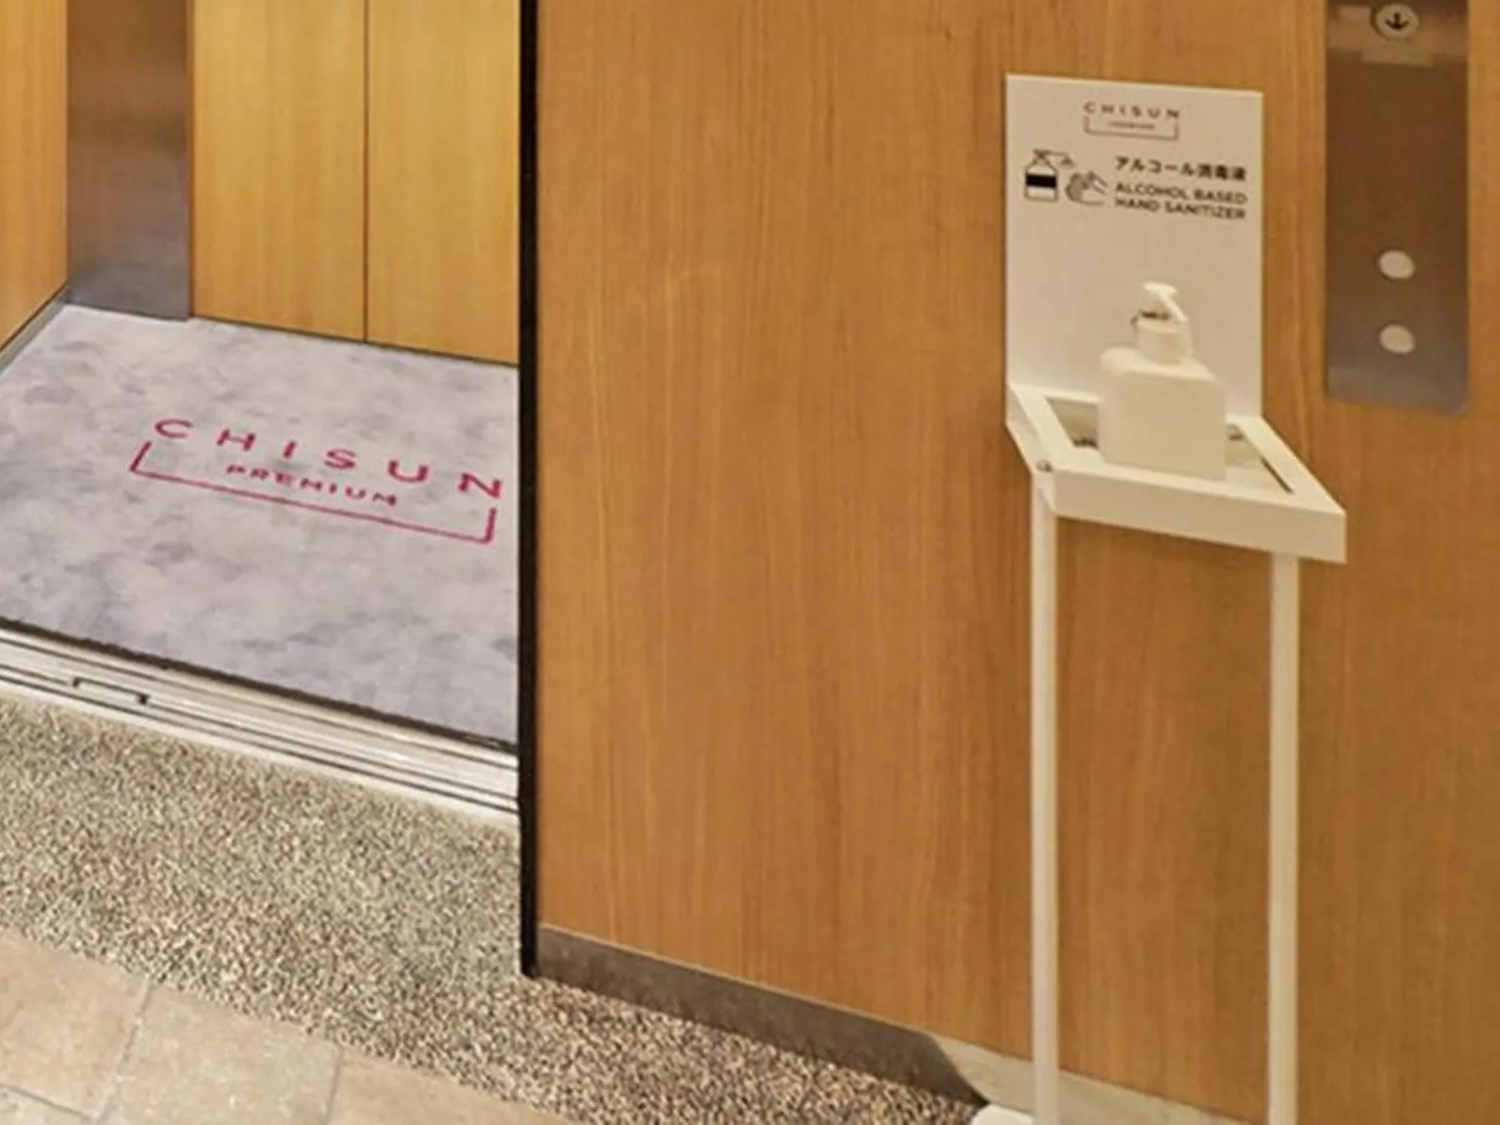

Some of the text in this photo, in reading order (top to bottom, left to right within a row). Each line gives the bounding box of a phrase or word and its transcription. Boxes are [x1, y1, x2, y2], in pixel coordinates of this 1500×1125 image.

[1082, 101, 1180, 119] CHISUN
[1115, 182, 1248, 205] ALCOHOL BASED
[1115, 197, 1246, 220] HAND SANITIZER
[153, 417, 502, 500] CHISUN
[225, 462, 398, 507] PREMIUM
